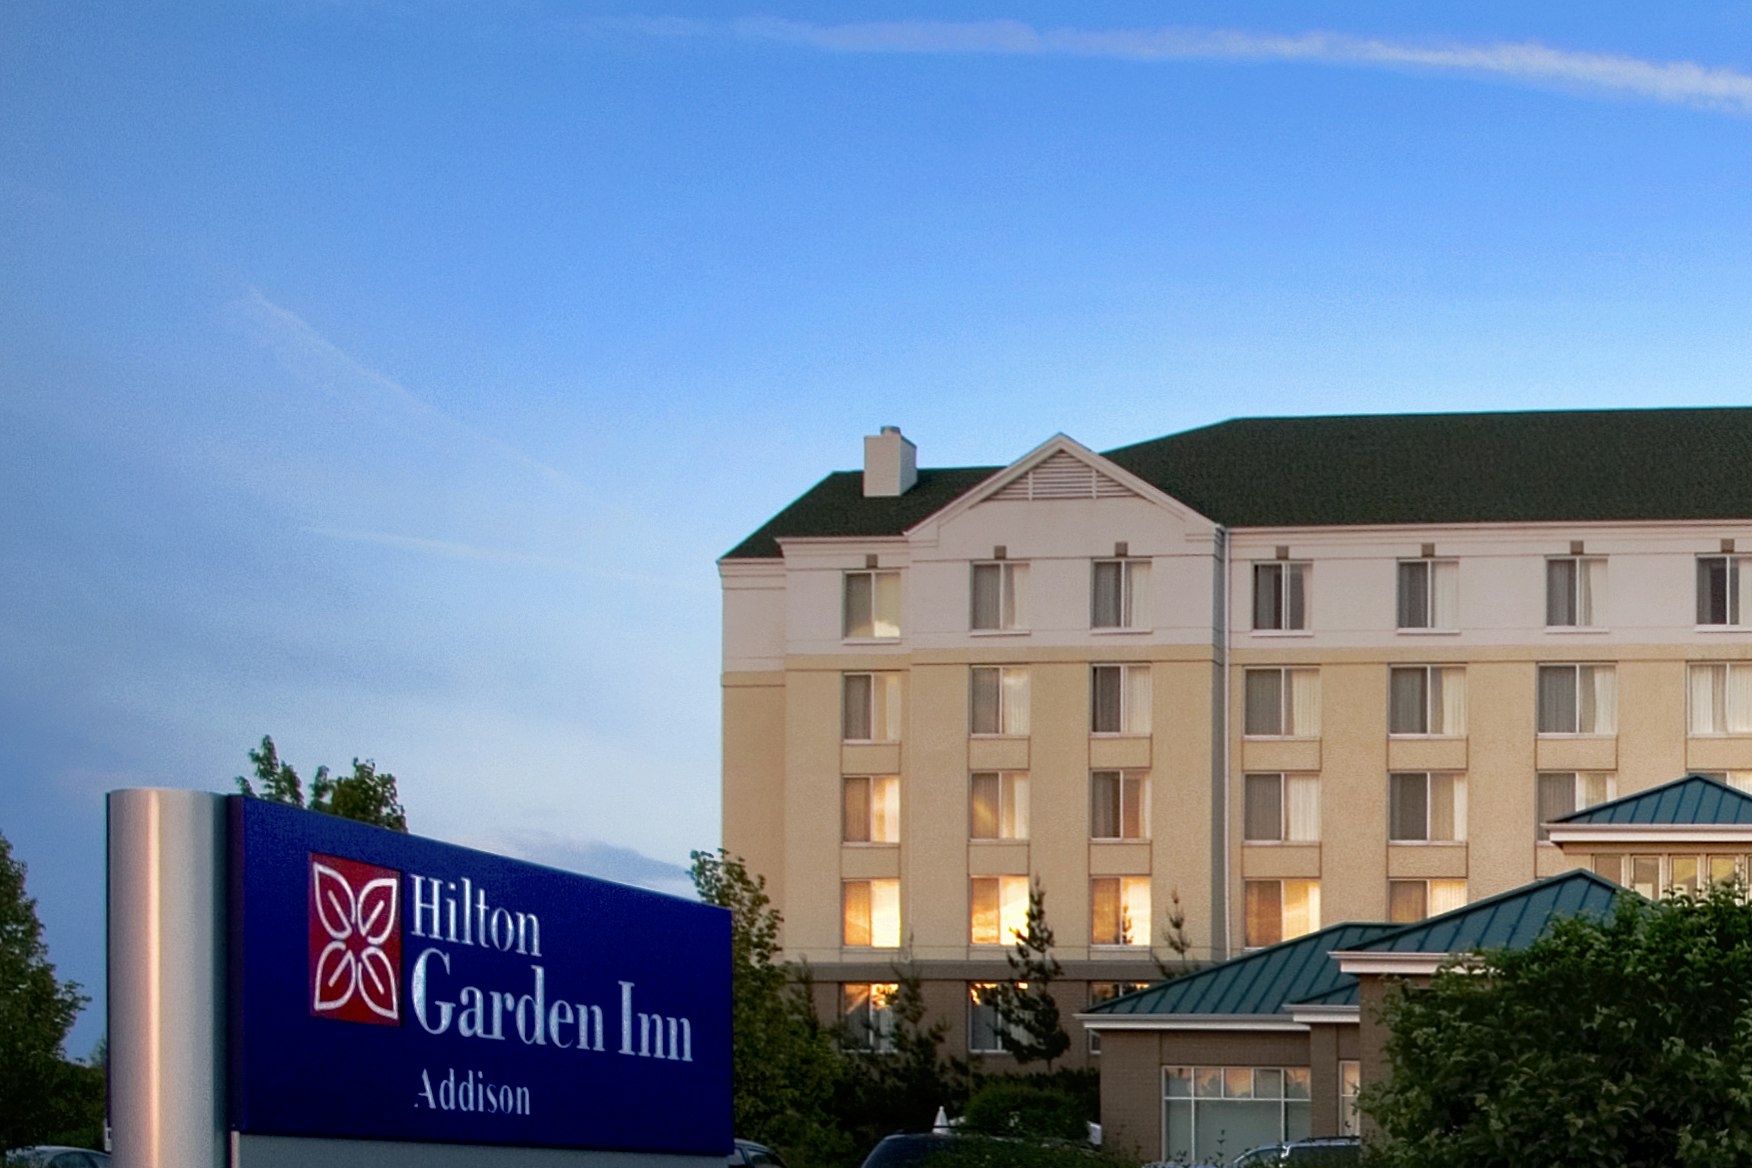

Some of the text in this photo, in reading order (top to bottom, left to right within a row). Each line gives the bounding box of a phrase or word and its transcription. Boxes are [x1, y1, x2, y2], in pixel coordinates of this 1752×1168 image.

[411, 874, 542, 957] Hilton
[411, 948, 693, 1062] Garden Inn
[413, 1067, 530, 1115] Addison
